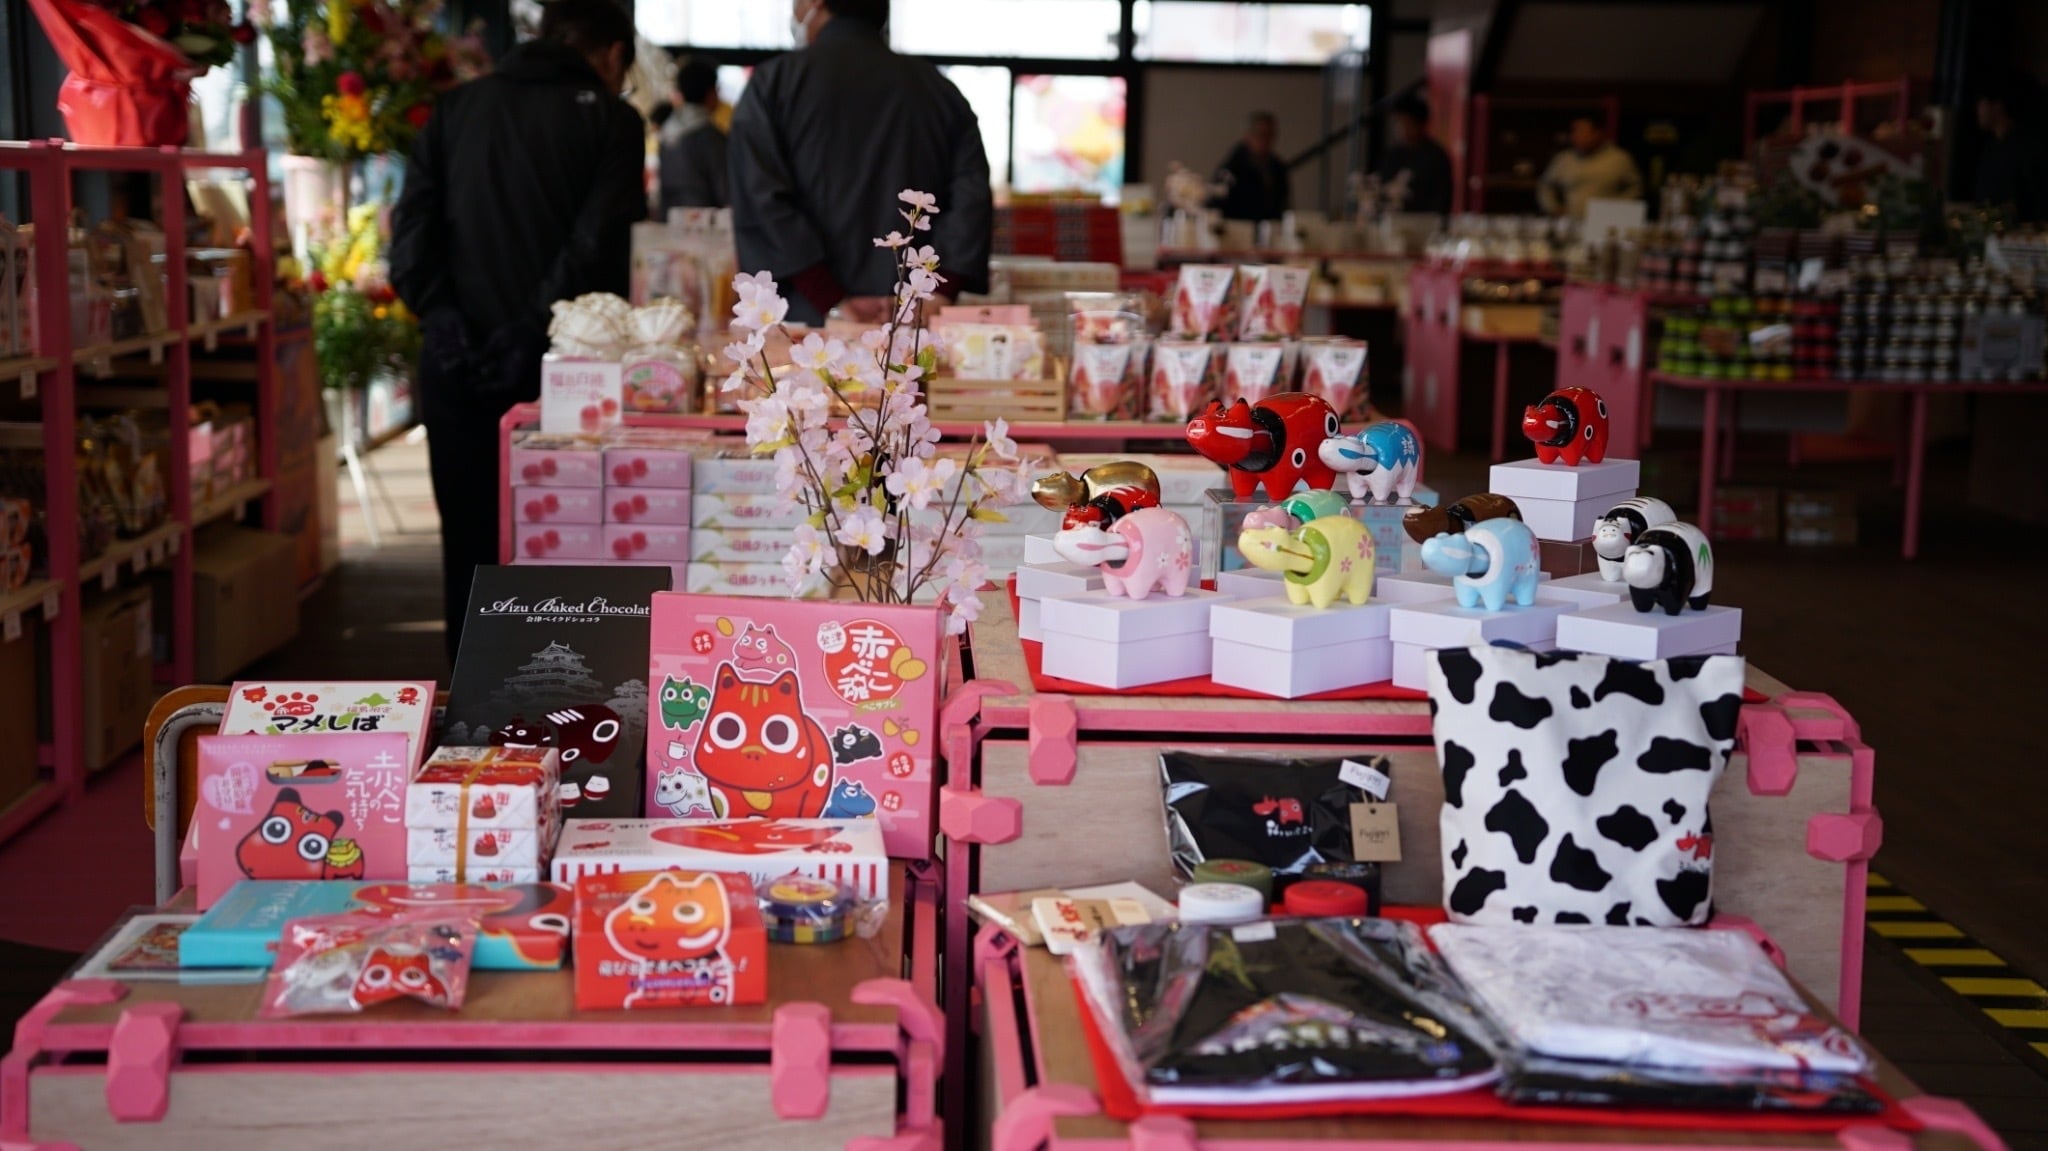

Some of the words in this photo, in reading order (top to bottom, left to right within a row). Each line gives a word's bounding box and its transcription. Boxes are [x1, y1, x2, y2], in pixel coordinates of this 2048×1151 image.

[480, 597, 528, 613] Aizu
[533, 597, 584, 613] Baked
[588, 597, 650, 615] Chocolat
[525, 615, 601, 623] 会津ベイクドショコラ
[271, 714, 385, 732] マメしば
